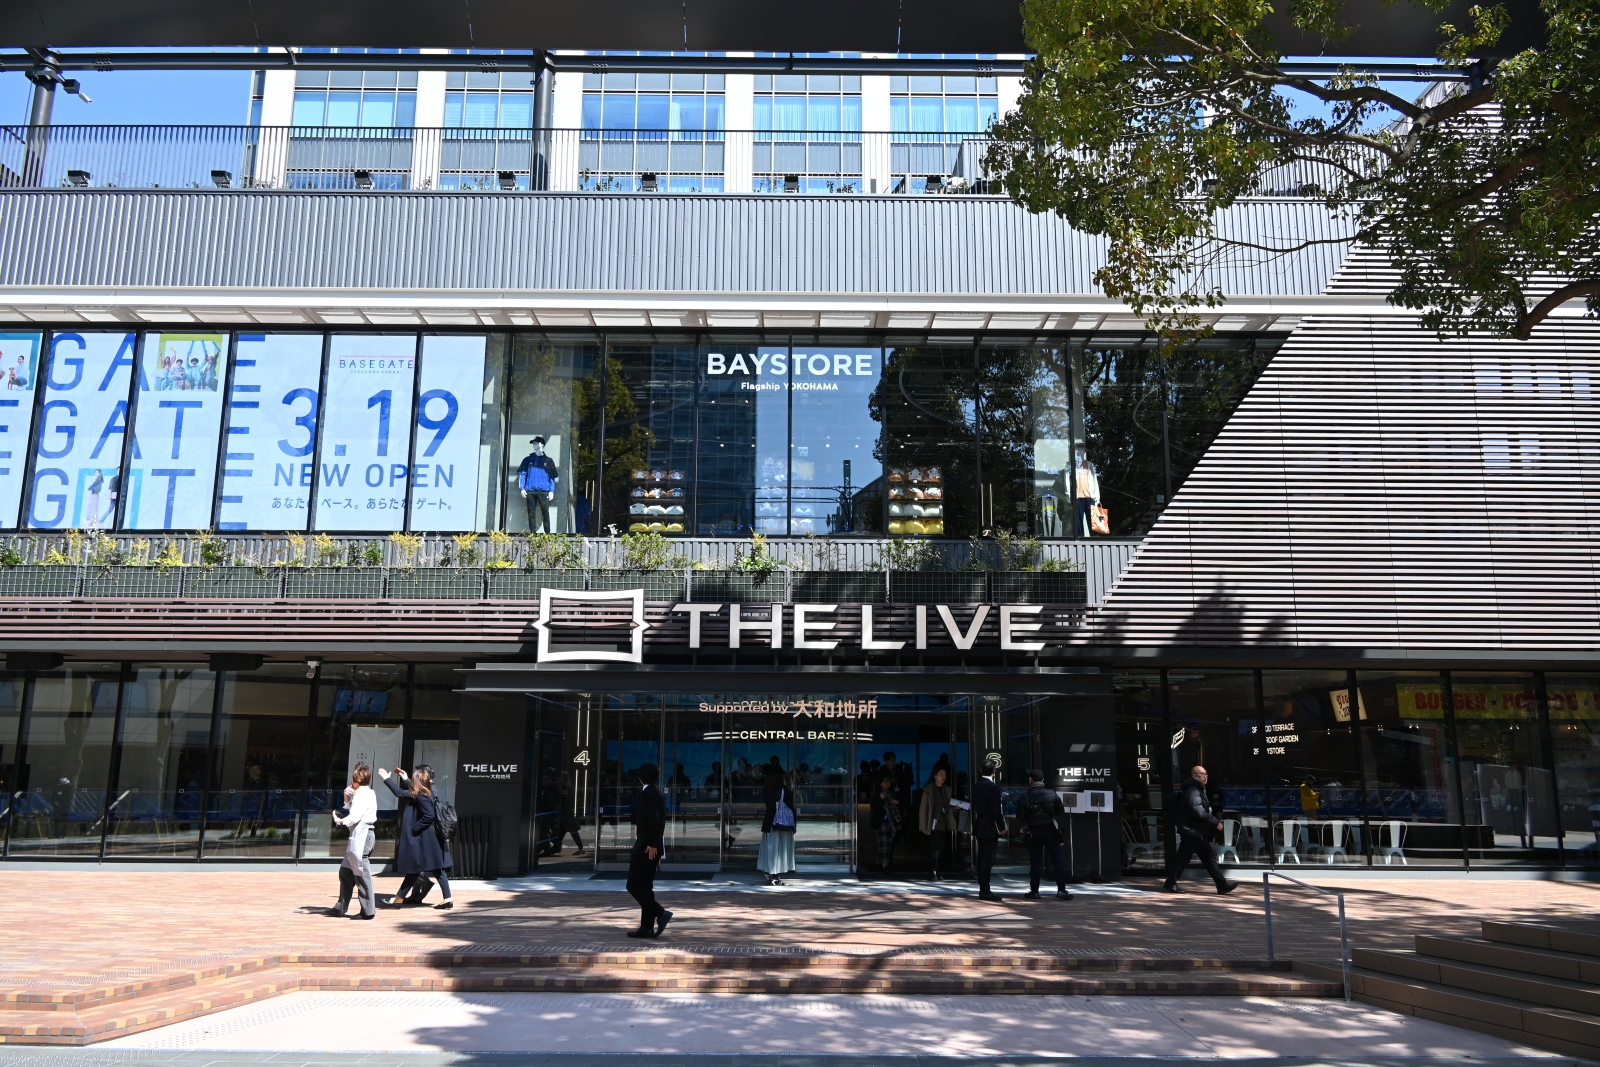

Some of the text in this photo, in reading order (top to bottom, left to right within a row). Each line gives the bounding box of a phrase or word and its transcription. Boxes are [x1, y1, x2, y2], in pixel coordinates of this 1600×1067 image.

[340, 360, 414, 369] BASEGATE
[707, 353, 873, 376] BAYSTORE
[741, 382, 838, 391] Flagship YOKOHAMA
[277, 387, 459, 457] 3.19
[273, 463, 455, 488] NEW OPEN
[671, 603, 1046, 651] THE LIVE
[1415, 692, 1487, 711] BUGER
[699, 702, 770, 713] Supported
[772, 702, 789, 714] by
[792, 700, 878, 719] 大和地所
[1272, 723, 1295, 732] TERRACE
[740, 731, 836, 740] CENTRAL BAR
[1279, 735, 1299, 743] GARDEN
[1266, 747, 1286, 755] YSTORE
[573, 750, 591, 766] 4
[463, 764, 518, 772] THE LIVE
[1137, 757, 1151, 771] 5
[1056, 767, 1111, 776] THE LIVE
